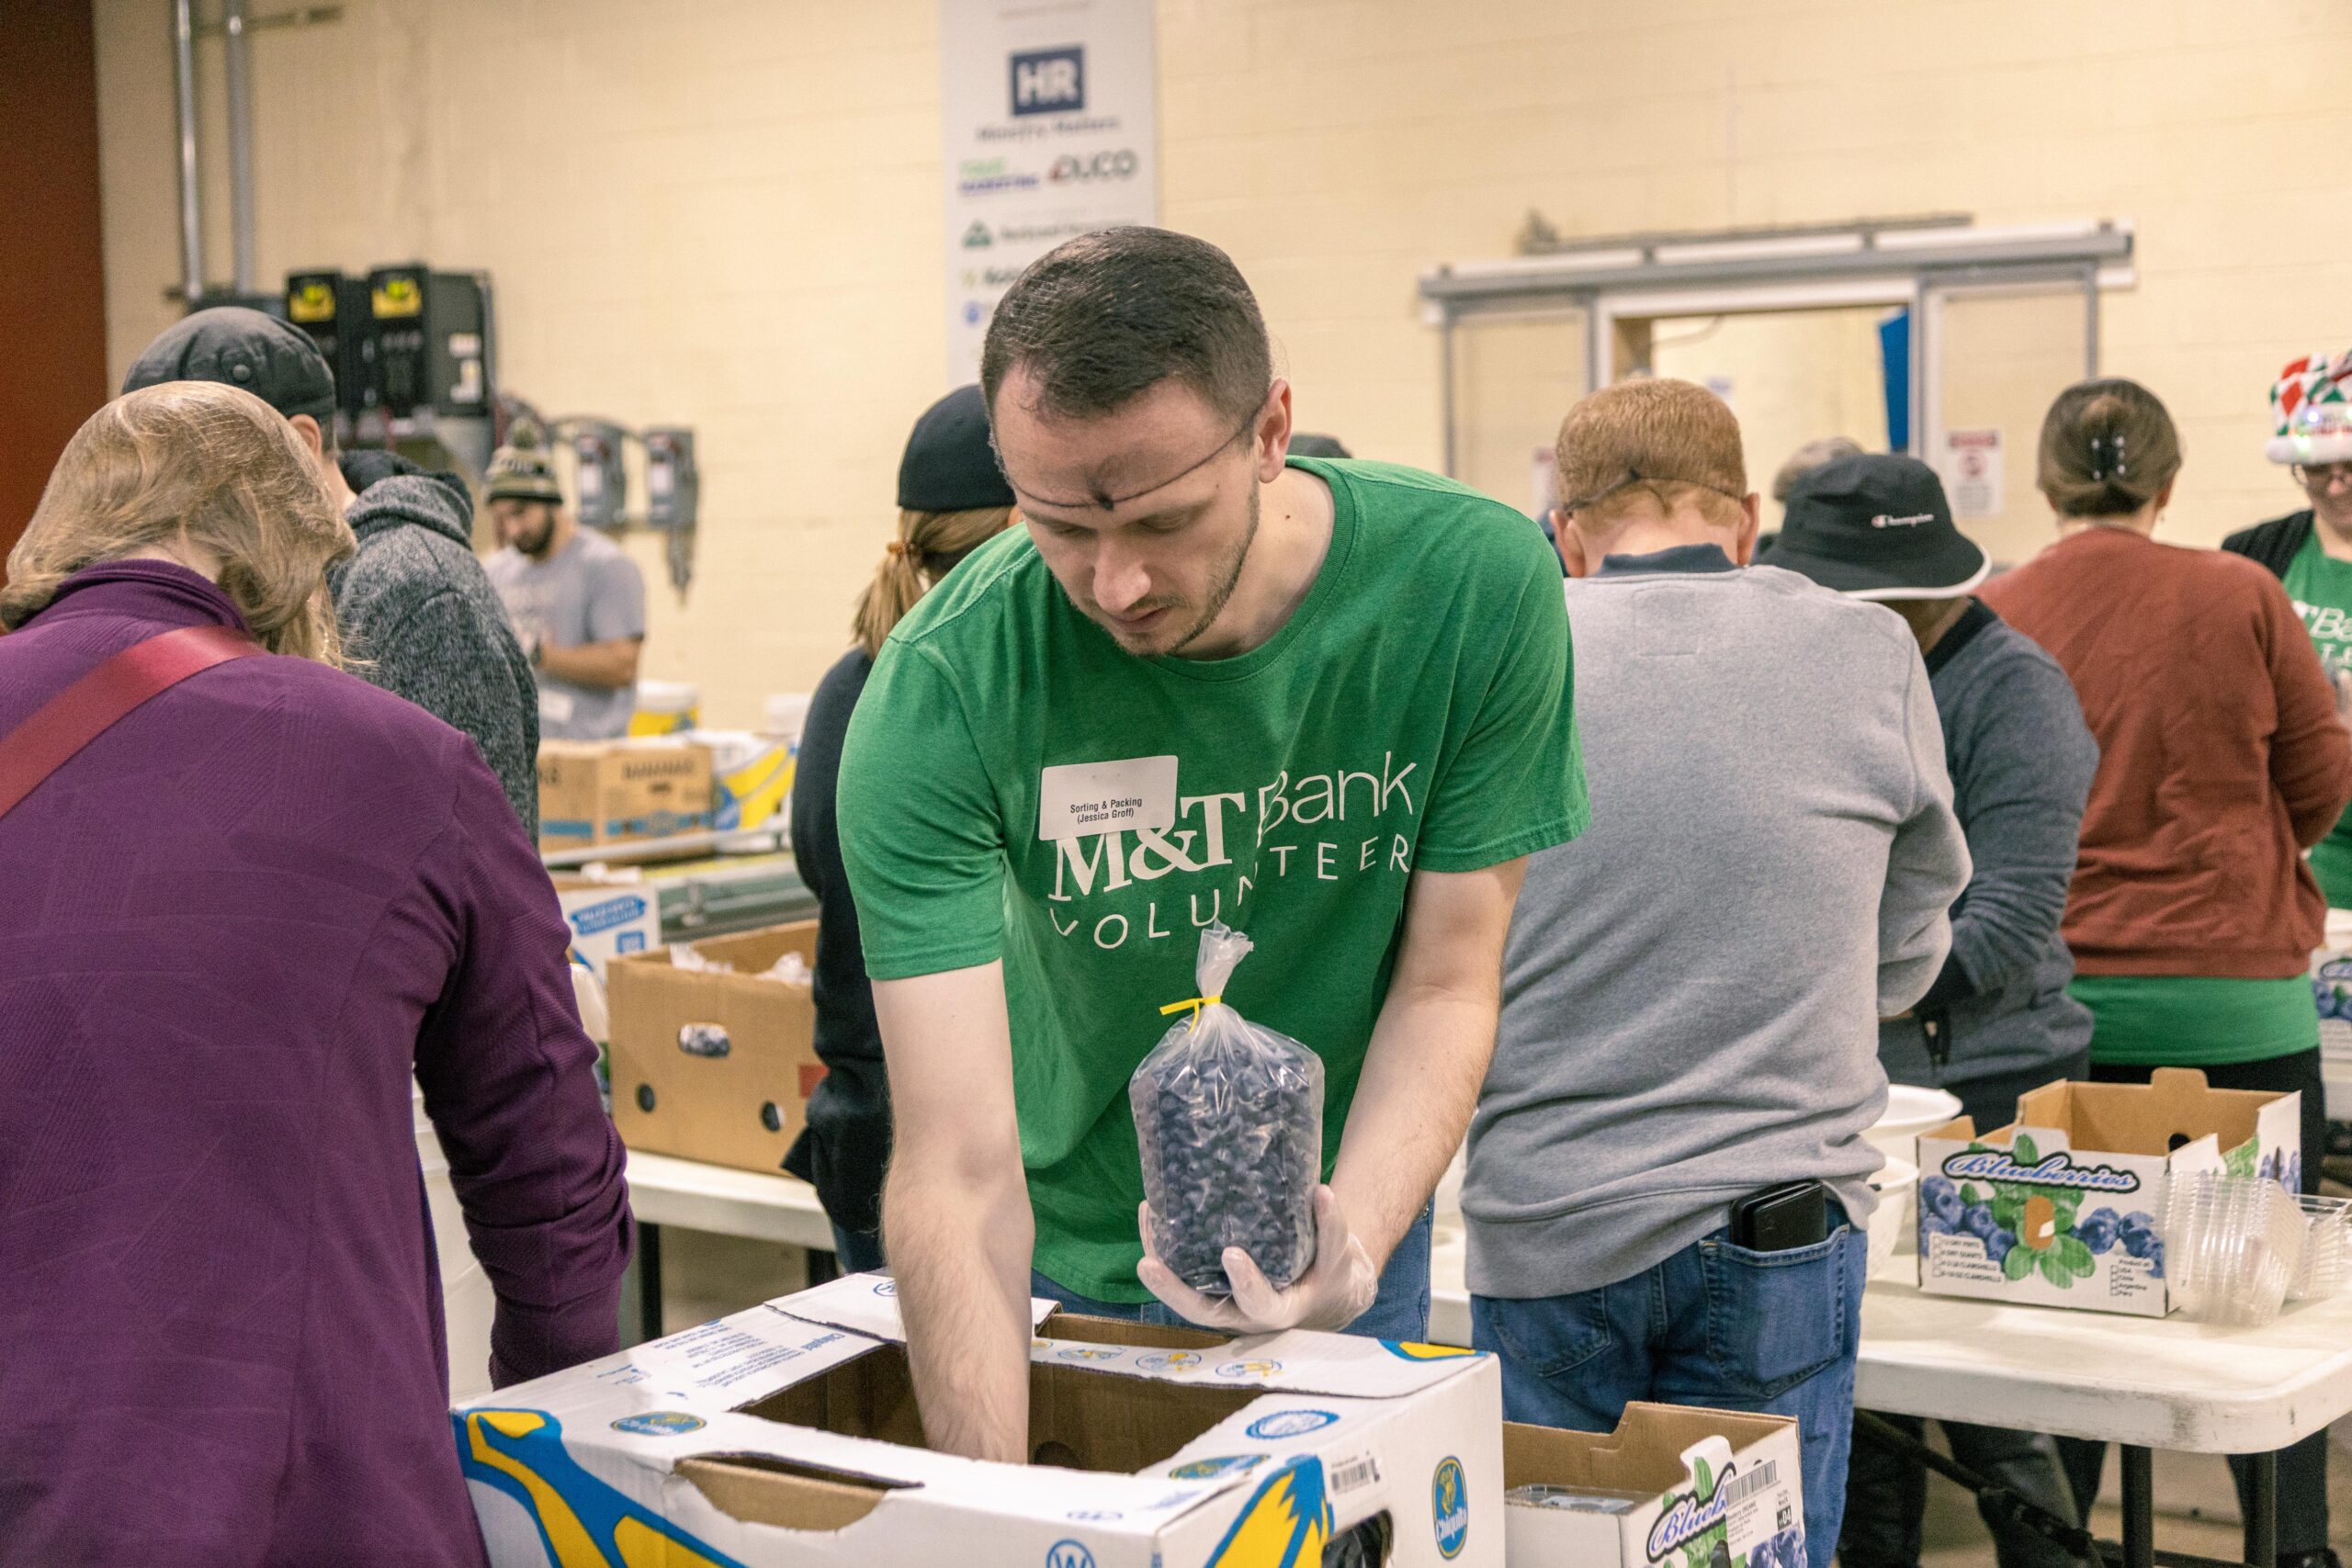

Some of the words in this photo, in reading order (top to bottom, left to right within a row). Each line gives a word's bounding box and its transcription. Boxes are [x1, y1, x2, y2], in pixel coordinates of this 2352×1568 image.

[1017, 59, 1078, 106] HR
[1871, 513, 1934, 528] Champion
[1069, 802, 1099, 814] Sorting
[1102, 800, 1107, 809] &
[1110, 797, 1143, 808] Packing
[1077, 811, 1109, 824] (Jessica
[1112, 807, 1135, 818] Groff)
[1048, 793, 1246, 901] M&T
[1257, 750, 1417, 848] Bank
[1946, 1154, 2132, 1186] Blueberries
[1435, 1506, 1467, 1542] Chiquita
